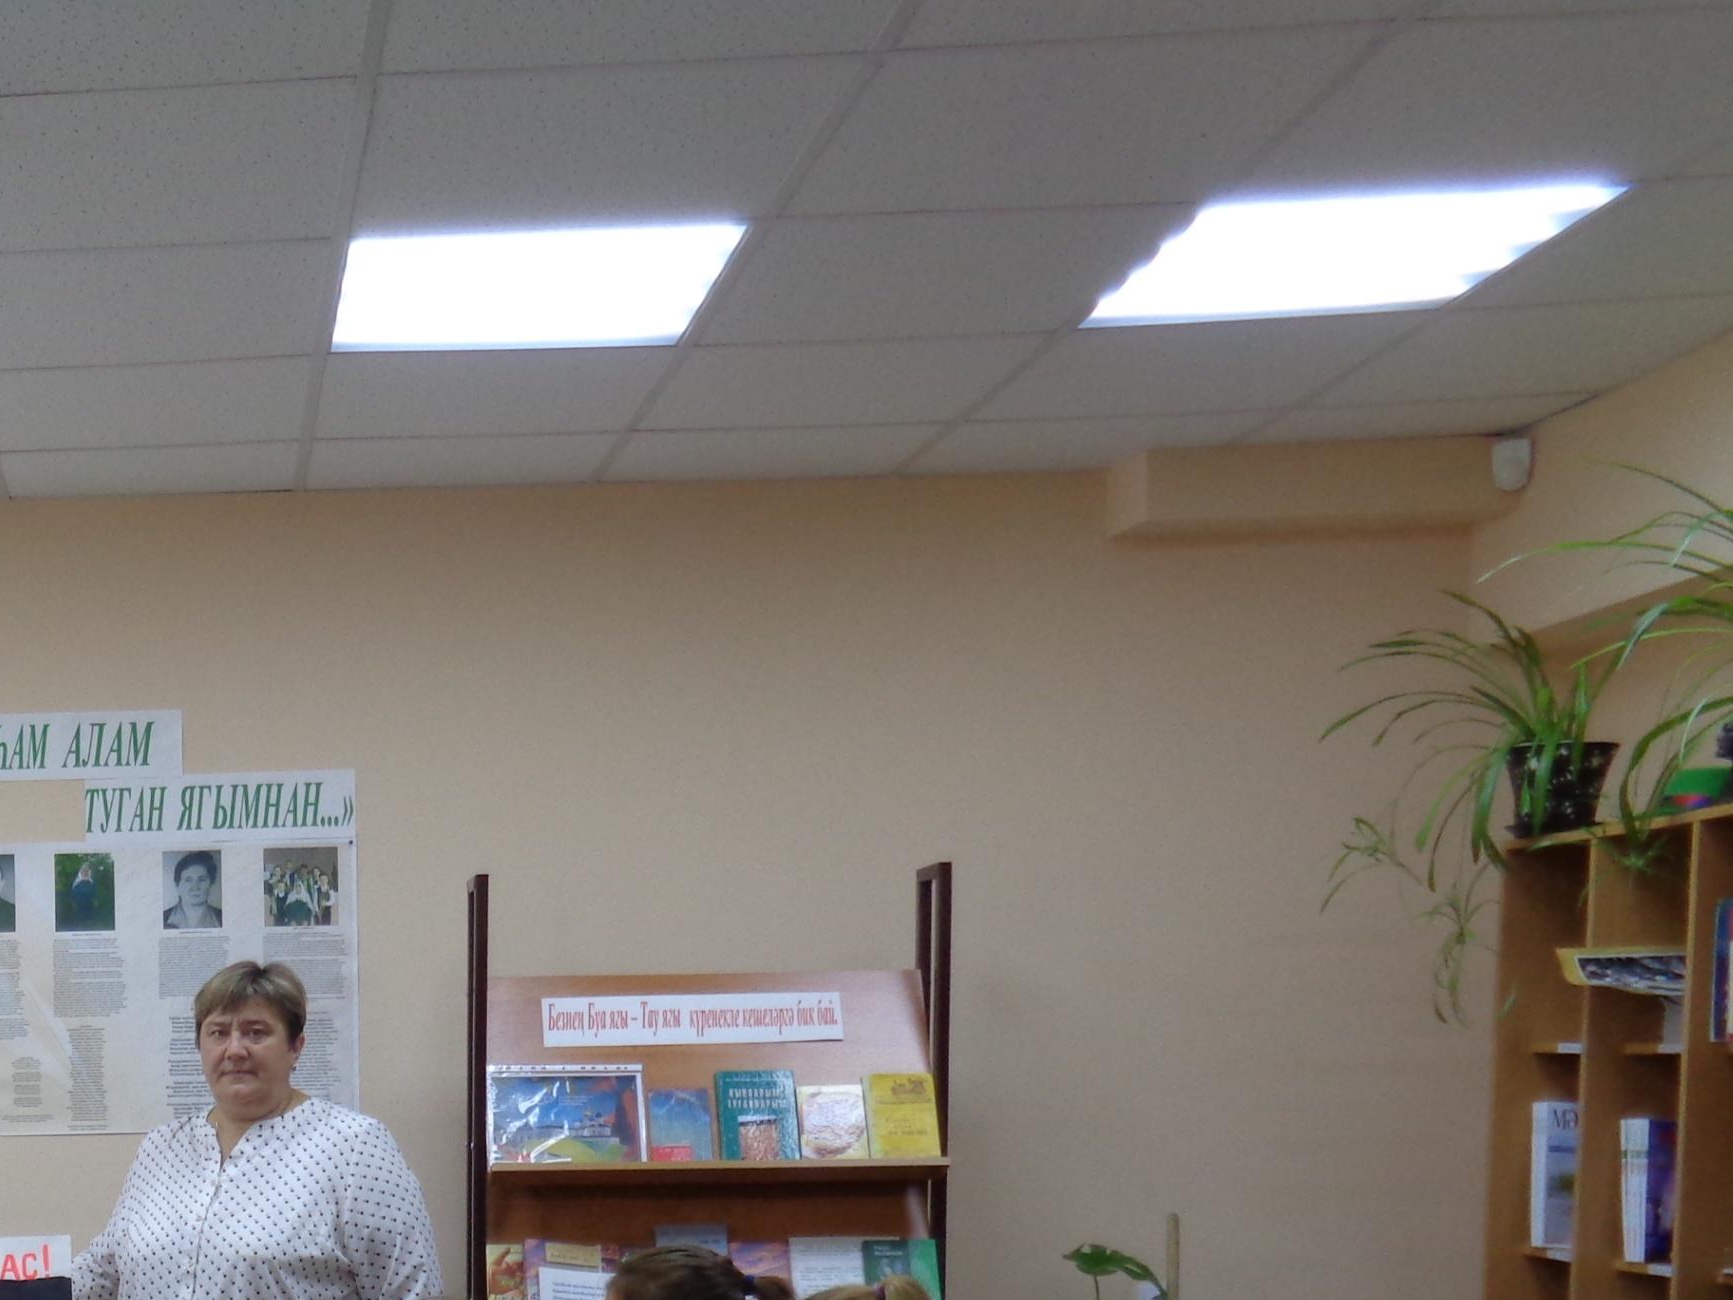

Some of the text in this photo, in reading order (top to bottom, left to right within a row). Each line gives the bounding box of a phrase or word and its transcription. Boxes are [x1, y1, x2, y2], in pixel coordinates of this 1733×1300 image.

[62, 720, 155, 768] АЛАМ
[85, 786, 167, 833] ТУГАН
[588, 1002, 606, 1038] Буа
[640, 1001, 659, 1037] Тау
[797, 999, 815, 1026] бик
